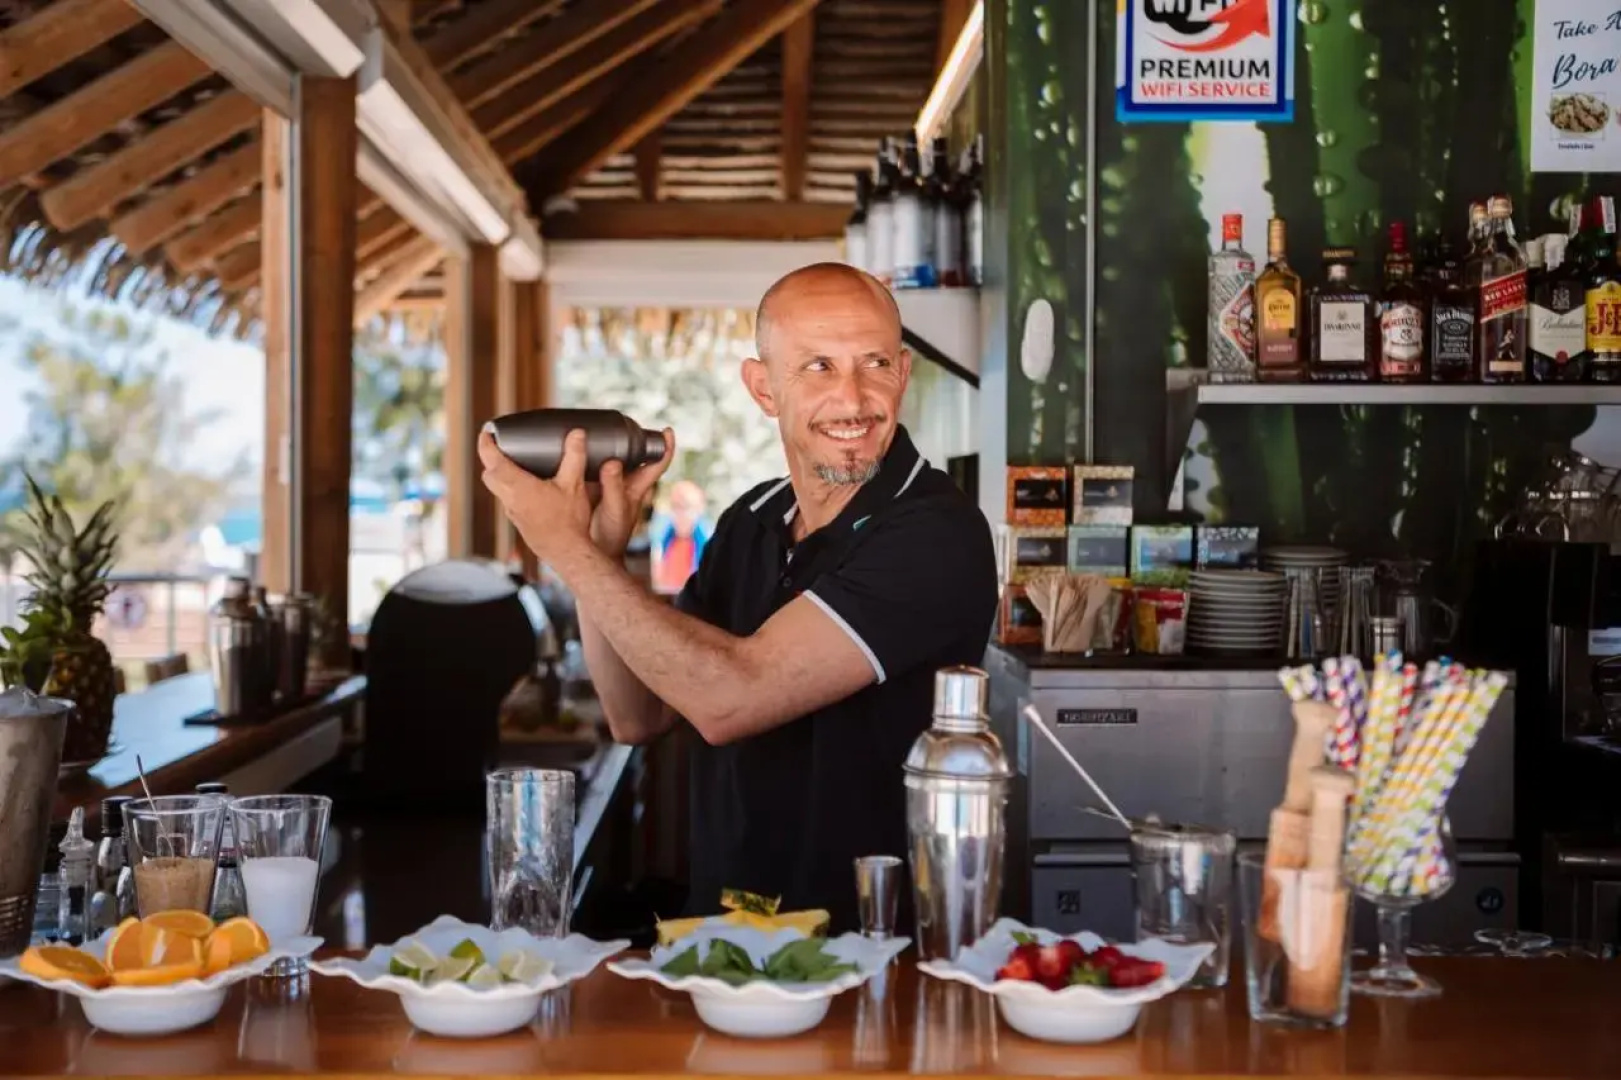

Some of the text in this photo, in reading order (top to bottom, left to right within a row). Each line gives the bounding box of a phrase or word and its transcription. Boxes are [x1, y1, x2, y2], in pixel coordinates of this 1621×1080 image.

[1553, 20, 1598, 40] Take
[1140, 59, 1271, 79] PREMIUM
[1552, 52, 1618, 90] Bora
[1140, 82, 1272, 98] WIFI SERVICE
